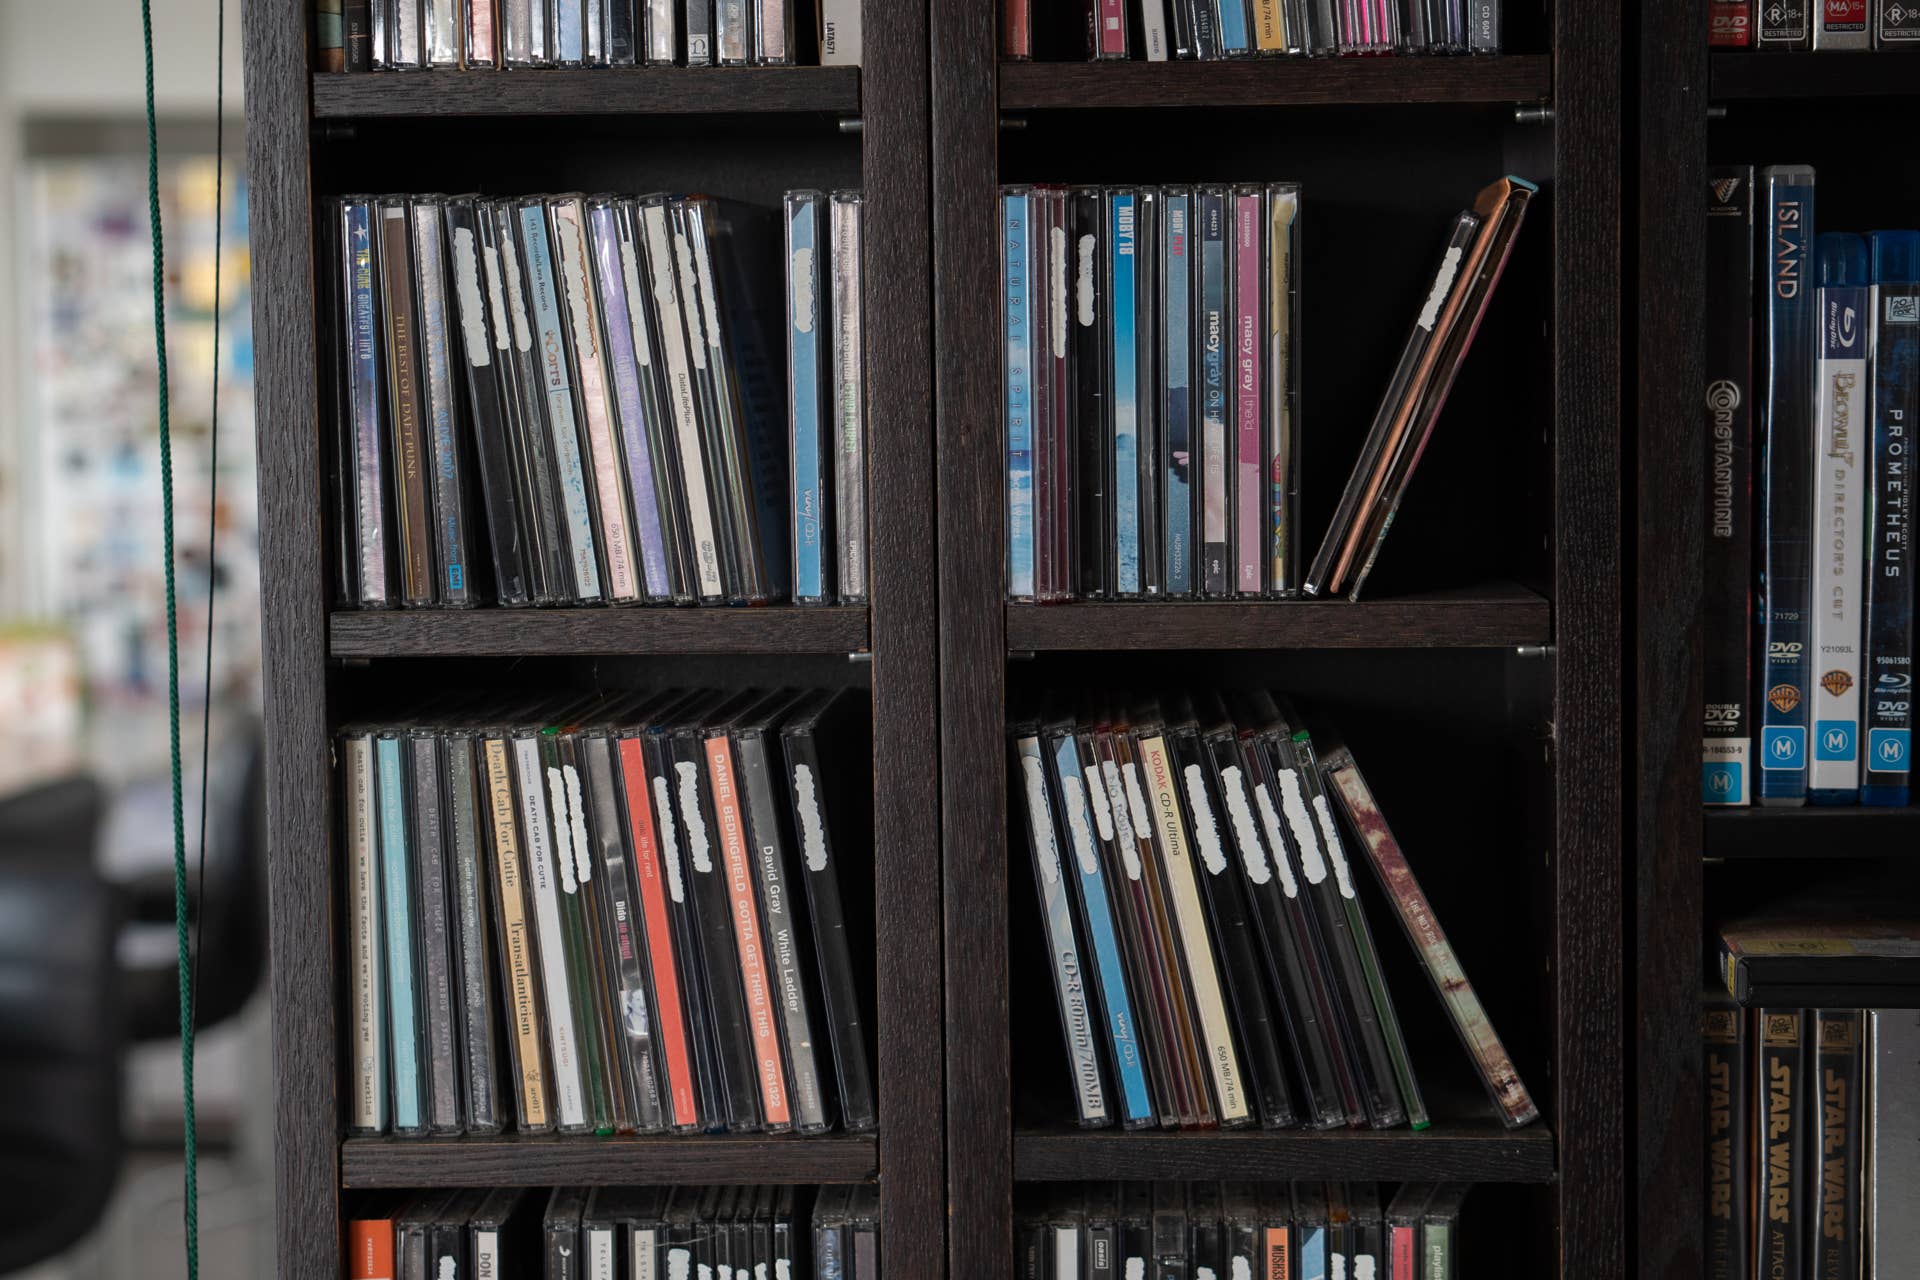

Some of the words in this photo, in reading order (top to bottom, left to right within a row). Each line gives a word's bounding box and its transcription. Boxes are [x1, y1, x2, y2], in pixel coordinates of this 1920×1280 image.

[1481, 5, 1489, 18] CD
[1712, 16, 1748, 26] DVD
[1770, 9, 1779, 21] R
[1787, 9, 1803, 19] 18+
[1830, 2, 1849, 12] MA
[1851, 2, 1865, 10] 15+
[1891, 8, 1900, 21] R
[827, 22, 835, 55] LATA571
[1264, 22, 1272, 39] min
[1481, 20, 1490, 39] 6047
[529, 217, 538, 231] 141
[1118, 206, 1134, 238] MOBY
[1172, 210, 1184, 233] MOBY
[530, 232, 545, 281] Records/Lava
[1119, 241, 1134, 255] 18
[1172, 236, 1184, 256] PLAY
[1777, 201, 1799, 299] ISLAND
[1799, 239, 1807, 258] THE
[356, 266, 370, 289] CURE
[1008, 219, 1021, 341] NATURAL
[537, 282, 549, 312] Records
[358, 294, 371, 335] GREATEST
[396, 312, 407, 341] THE
[842, 314, 853, 331] The
[1242, 315, 1253, 354] macy
[359, 338, 373, 360] HITS
[397, 344, 409, 374] BEST
[843, 334, 855, 380] Essential
[398, 377, 410, 395] OF
[1242, 358, 1255, 392] gray
[1010, 368, 1023, 457] SPIRIT
[1209, 390, 1220, 407] ON
[401, 403, 413, 437] DAFT
[438, 409, 451, 446] ALIVE
[844, 415, 857, 453] LAUPER
[404, 442, 417, 480] PUNK
[441, 449, 454, 480] 2007
[1209, 463, 1220, 474] IS
[1706, 380, 1741, 537] CONSTANTINE
[1885, 409, 1903, 577] PROMETHEUS
[447, 517, 457, 543] Music
[1833, 469, 1845, 577] DIRECTOR'S
[609, 523, 620, 539] 650
[618, 571, 627, 588] min
[1211, 559, 1220, 575] epic
[1774, 612, 1799, 620] 71729
[1832, 586, 1843, 621] CUT
[1768, 642, 1803, 652] DVD
[1704, 710, 1740, 720] DVD
[1877, 701, 1909, 711] DVD
[1776, 740, 1791, 755] M
[1828, 733, 1843, 748] M
[1884, 743, 1899, 758] M
[356, 749, 364, 774] death
[490, 743, 508, 785] Death
[357, 779, 365, 794] cab
[714, 754, 729, 802] DANIEL
[1713, 774, 1729, 790] M
[358, 798, 366, 812] for
[495, 788, 511, 817] Cab
[528, 795, 538, 823] DEATH
[1150, 750, 1167, 790] KODAK
[1159, 792, 1173, 818] CD-R
[1166, 821, 1180, 856] Ultima
[359, 817, 367, 843] cutie
[427, 808, 436, 837] DEATH
[499, 821, 513, 846] For
[532, 825, 541, 843] CAB
[430, 847, 439, 865] CAB
[535, 845, 543, 863] FOR
[642, 849, 651, 861] for
[722, 805, 746, 892] BEDINGFIELD
[463, 857, 473, 880] death
[503, 849, 517, 888] Cutie
[538, 864, 547, 889] CUTIE
[644, 862, 653, 878] rent
[763, 845, 779, 881] David
[360, 871, 368, 892] have
[432, 876, 440, 893] FOR
[465, 881, 474, 894] cab
[466, 895, 474, 907] for
[768, 884, 783, 914] Gray
[1409, 898, 1421, 914] THE
[361, 915, 370, 940] facts
[467, 908, 475, 928] cutie
[615, 901, 626, 921] Dido
[621, 934, 633, 960] angel
[738, 899, 755, 941] GOTTA
[362, 944, 371, 960] and
[744, 944, 757, 968] GET
[777, 928, 792, 965] White
[362, 964, 371, 989] we're
[510, 917, 532, 1036] Transatlanticism
[1062, 951, 1083, 993] CD-R
[437, 975, 446, 1012] NARROW
[749, 972, 764, 1006] THRU
[783, 968, 799, 1013] Ladder
[360, 992, 371, 1023] voting
[362, 1026, 371, 1043] yes
[755, 1009, 769, 1038] THIS
[440, 1021, 450, 1057] STAIRS
[559, 1026, 569, 1067] KINTSUGI
[1069, 997, 1102, 1109] 80min/700MB
[764, 1059, 781, 1108] 0761322
[1217, 1046, 1227, 1061] 650
[1228, 1093, 1237, 1109] min
[1710, 1054, 1730, 1135] STAR
[1770, 1057, 1790, 1139] STAR
[1825, 1069, 1846, 1154] STAR
[1709, 1138, 1730, 1219] WARS
[1769, 1142, 1790, 1223] WARS
[1823, 1157, 1845, 1241] WARS
[480, 1252, 492, 1278] DON
[1096, 1241, 1105, 1267] oasis
